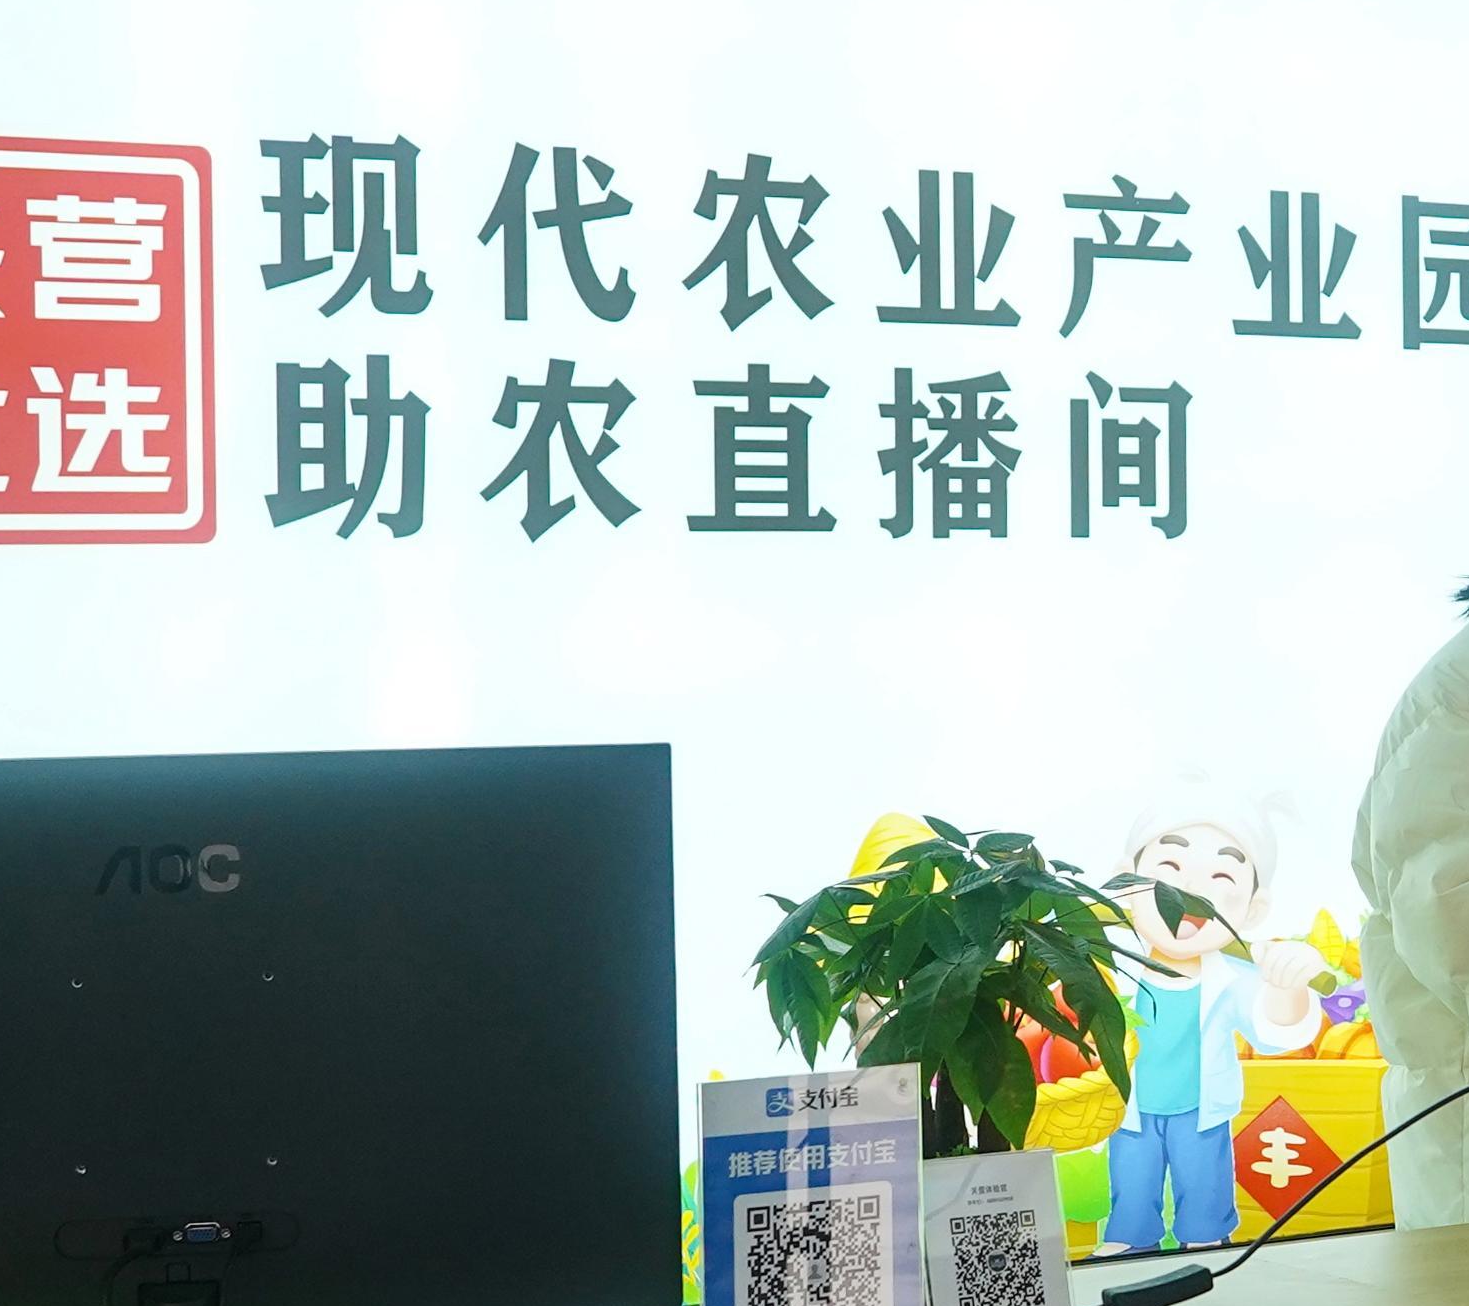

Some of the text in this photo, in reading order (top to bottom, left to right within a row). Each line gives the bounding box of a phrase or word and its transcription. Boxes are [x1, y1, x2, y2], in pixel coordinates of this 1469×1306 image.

[263, 353, 1194, 542] 助农直播间
[94, 843, 242, 896] AOC
[798, 1085, 859, 1112] 支付宝
[728, 1138, 897, 1179] 推荐使用支付宝
